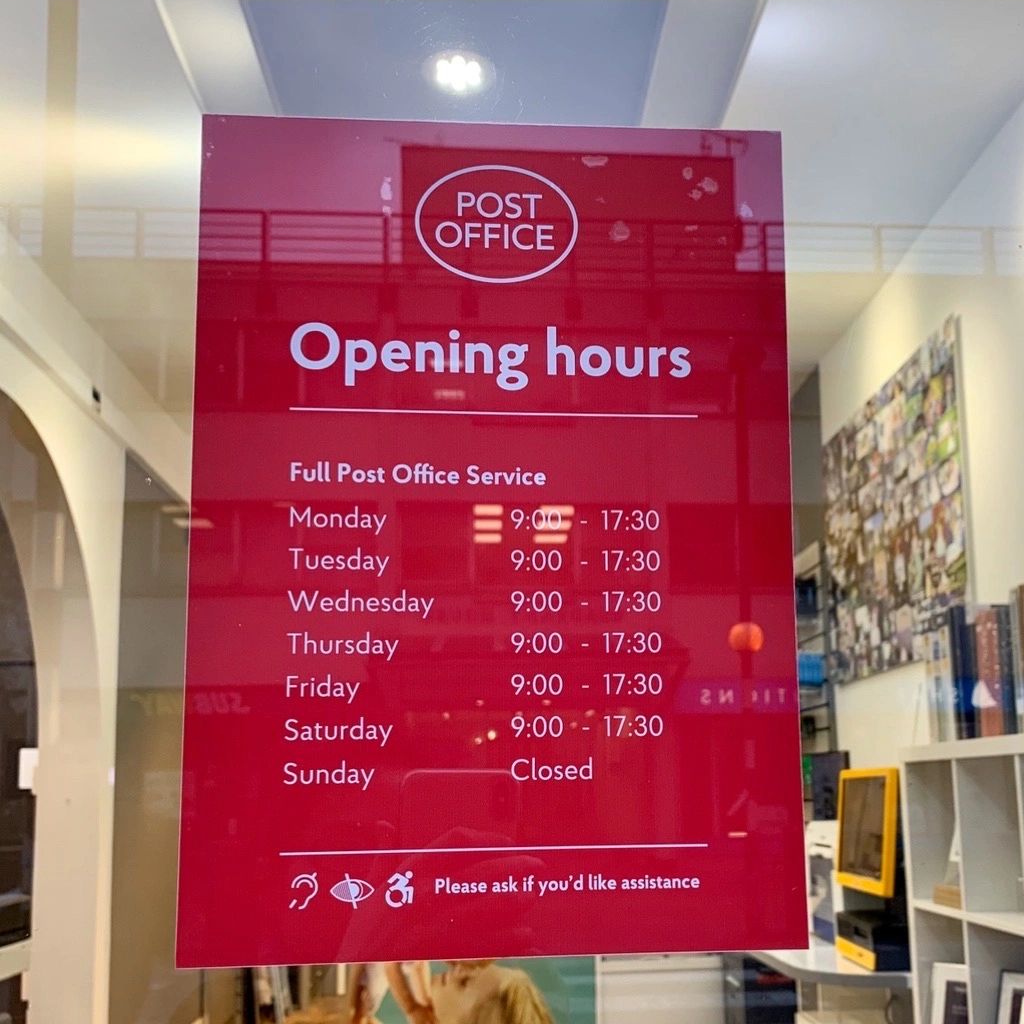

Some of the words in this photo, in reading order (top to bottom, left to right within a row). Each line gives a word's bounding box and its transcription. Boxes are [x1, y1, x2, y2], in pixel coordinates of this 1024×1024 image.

[458, 192, 542, 218] POST
[435, 221, 554, 250] OFFICE
[290, 323, 528, 391] Opening
[547, 326, 691, 377] hours
[291, 461, 330, 482] Full
[338, 463, 385, 483] Post
[392, 463, 459, 484] Office
[467, 465, 546, 485] Service
[290, 506, 386, 535] Monday
[510, 508, 563, 532] 9:00
[602, 510, 659, 530] 17:30
[289, 547, 389, 577] Tuesday
[511, 550, 562, 571] 9:00
[602, 550, 660, 571] 17:30
[288, 590, 434, 618] Wednesday
[511, 591, 562, 612] 9:00
[603, 591, 661, 612] 17:30
[287, 632, 398, 660] Thursday
[511, 632, 562, 653] 9:00
[603, 632, 661, 653] 17:30
[287, 674, 360, 703] Friday
[511, 674, 562, 695] 9:00
[604, 674, 662, 694] 17:30
[285, 717, 393, 746] Saturday
[511, 712, 563, 737] 9:00
[604, 715, 663, 736] 17:30
[284, 760, 374, 790] Sunday
[511, 757, 592, 780] Closed
[435, 877, 487, 894] Please
[492, 876, 518, 892] ask
[523, 875, 534, 891] if
[538, 874, 583, 896] you'd
[589, 874, 616, 890] like
[621, 875, 700, 889] assistance
